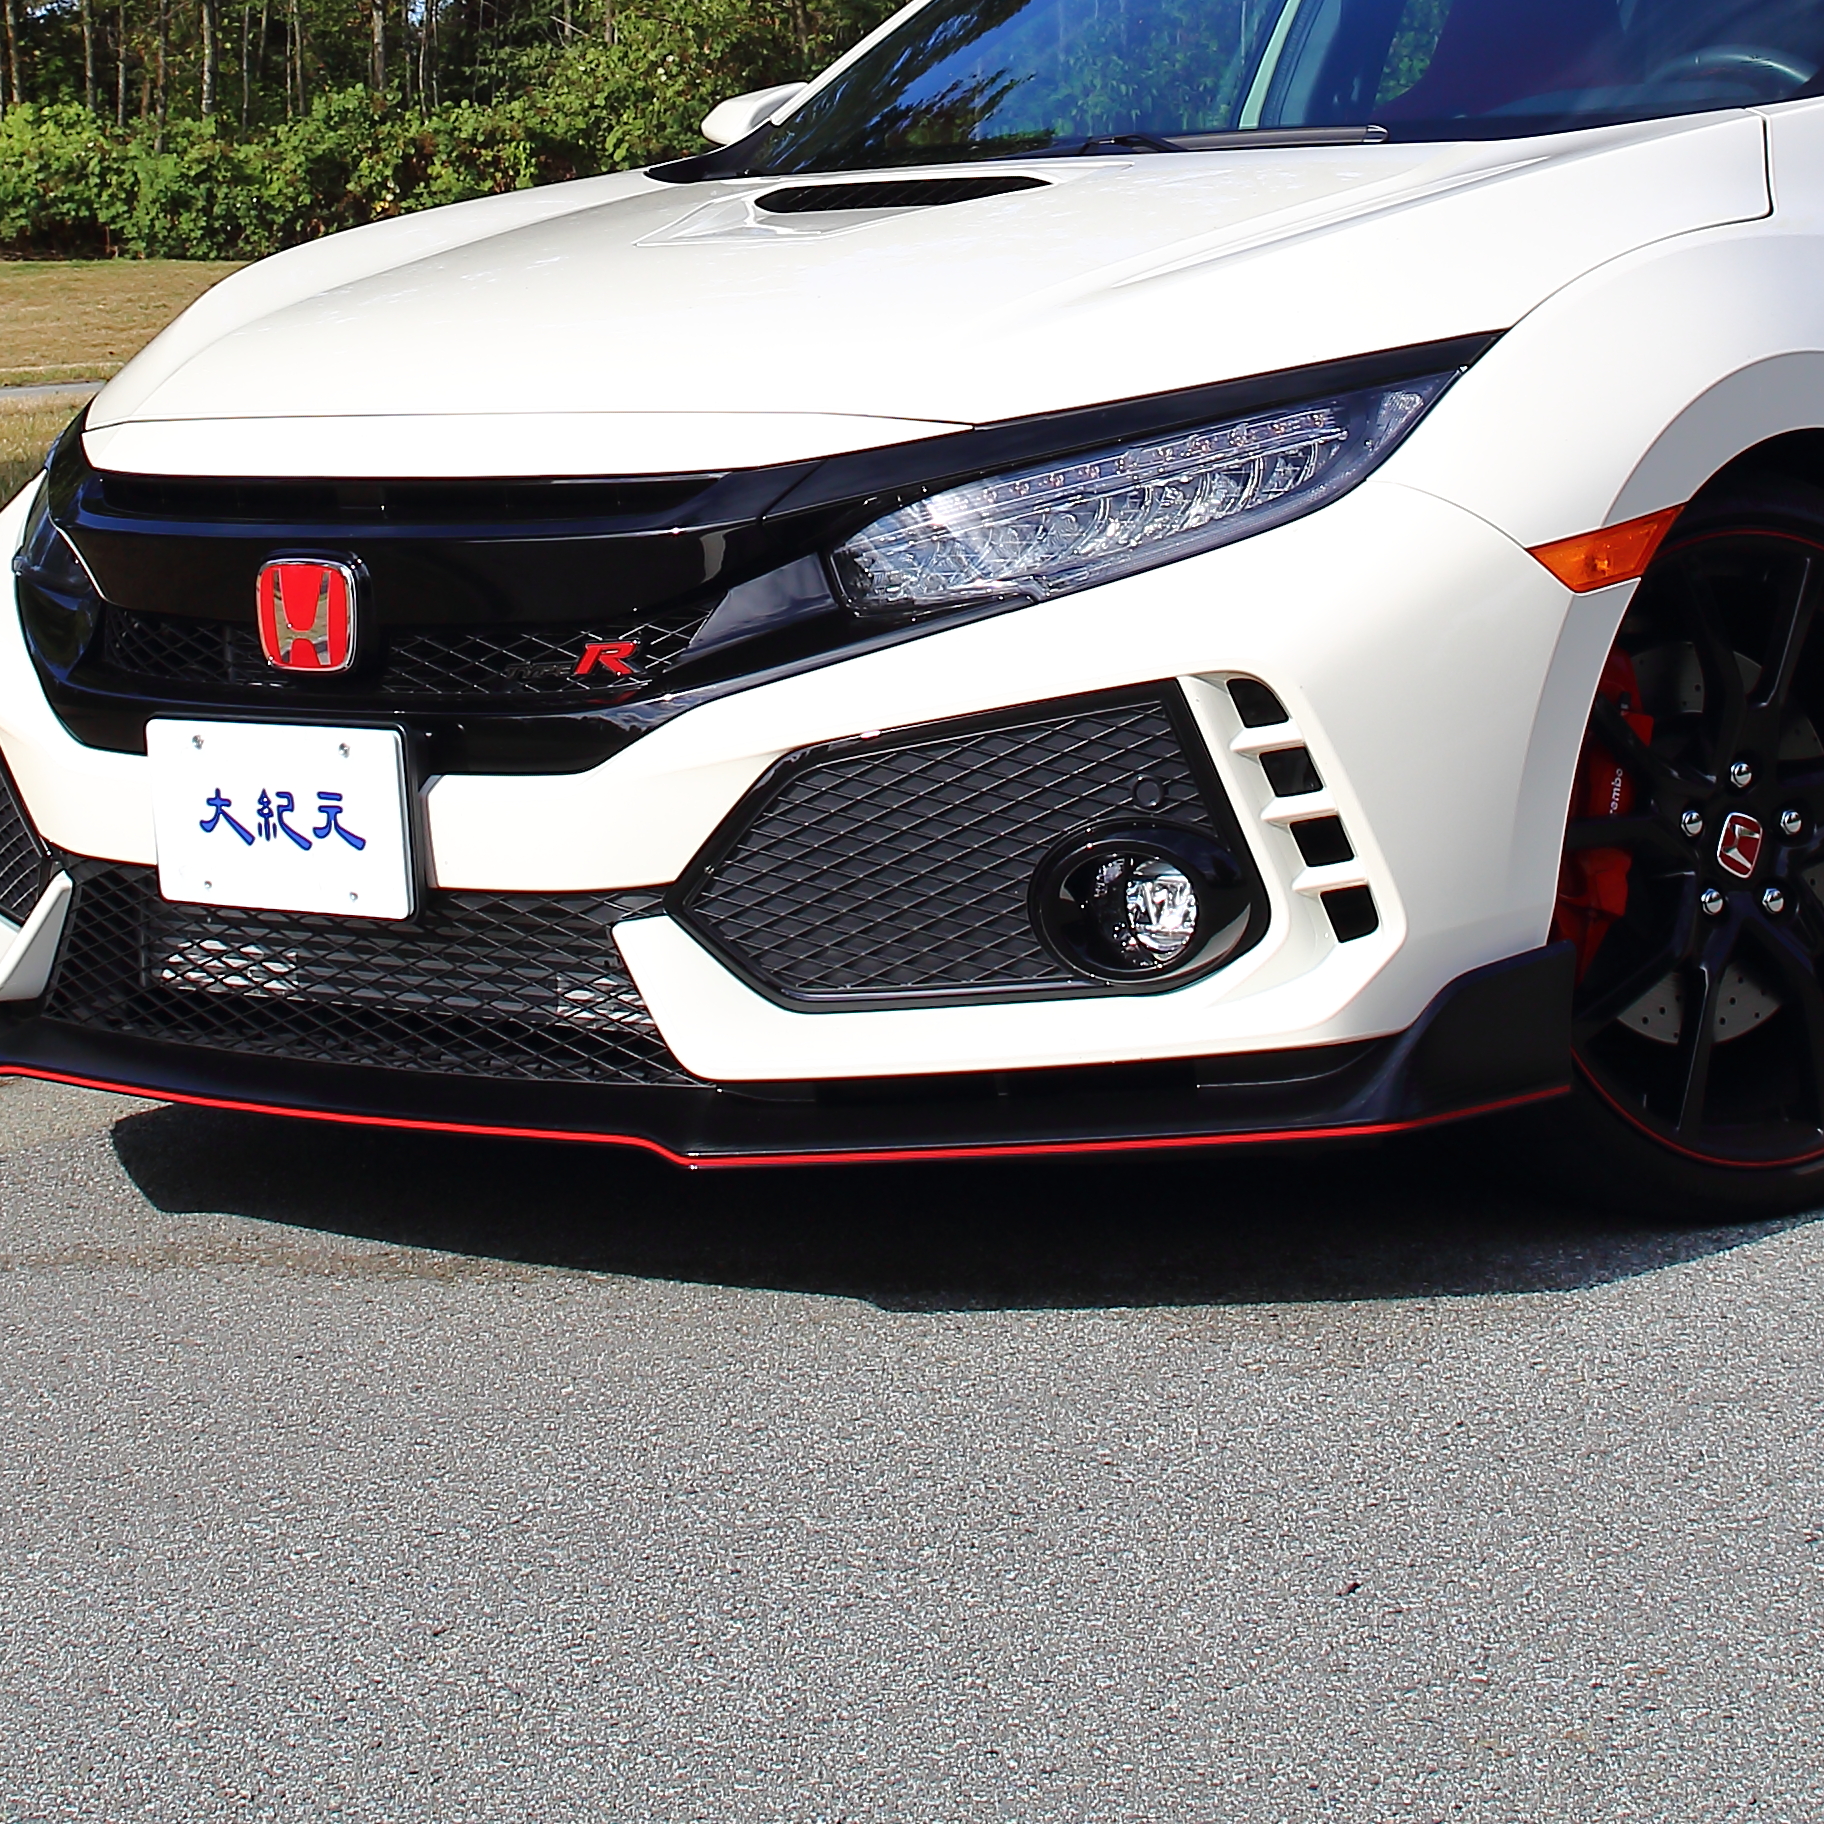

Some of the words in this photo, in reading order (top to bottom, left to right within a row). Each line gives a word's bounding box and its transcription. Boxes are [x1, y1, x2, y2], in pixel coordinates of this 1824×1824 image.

[505, 663, 573, 679] TYPE
[573, 640, 636, 675] R
[1609, 767, 1623, 814] embo
[199, 787, 366, 851] 大紀元
